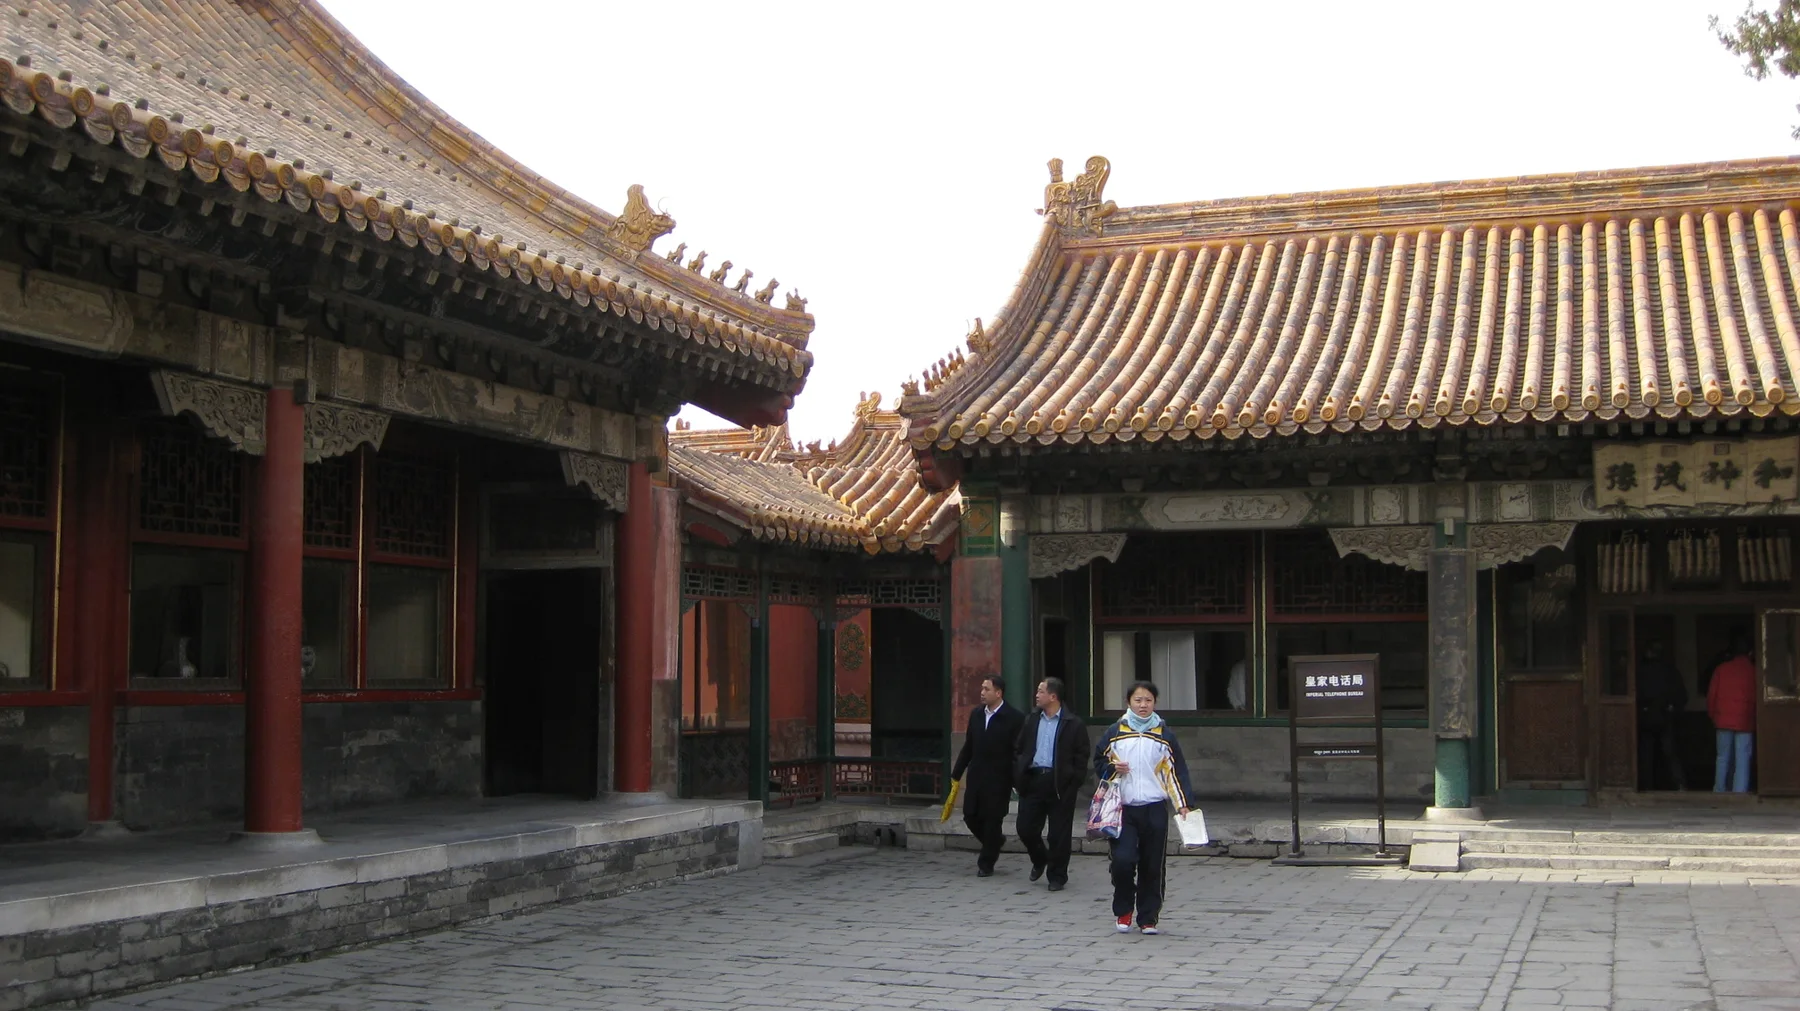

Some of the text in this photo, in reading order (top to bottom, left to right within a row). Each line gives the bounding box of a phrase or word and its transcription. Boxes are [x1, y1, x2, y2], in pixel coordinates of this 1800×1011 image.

[1305, 674, 1364, 687] 皇家电话局
